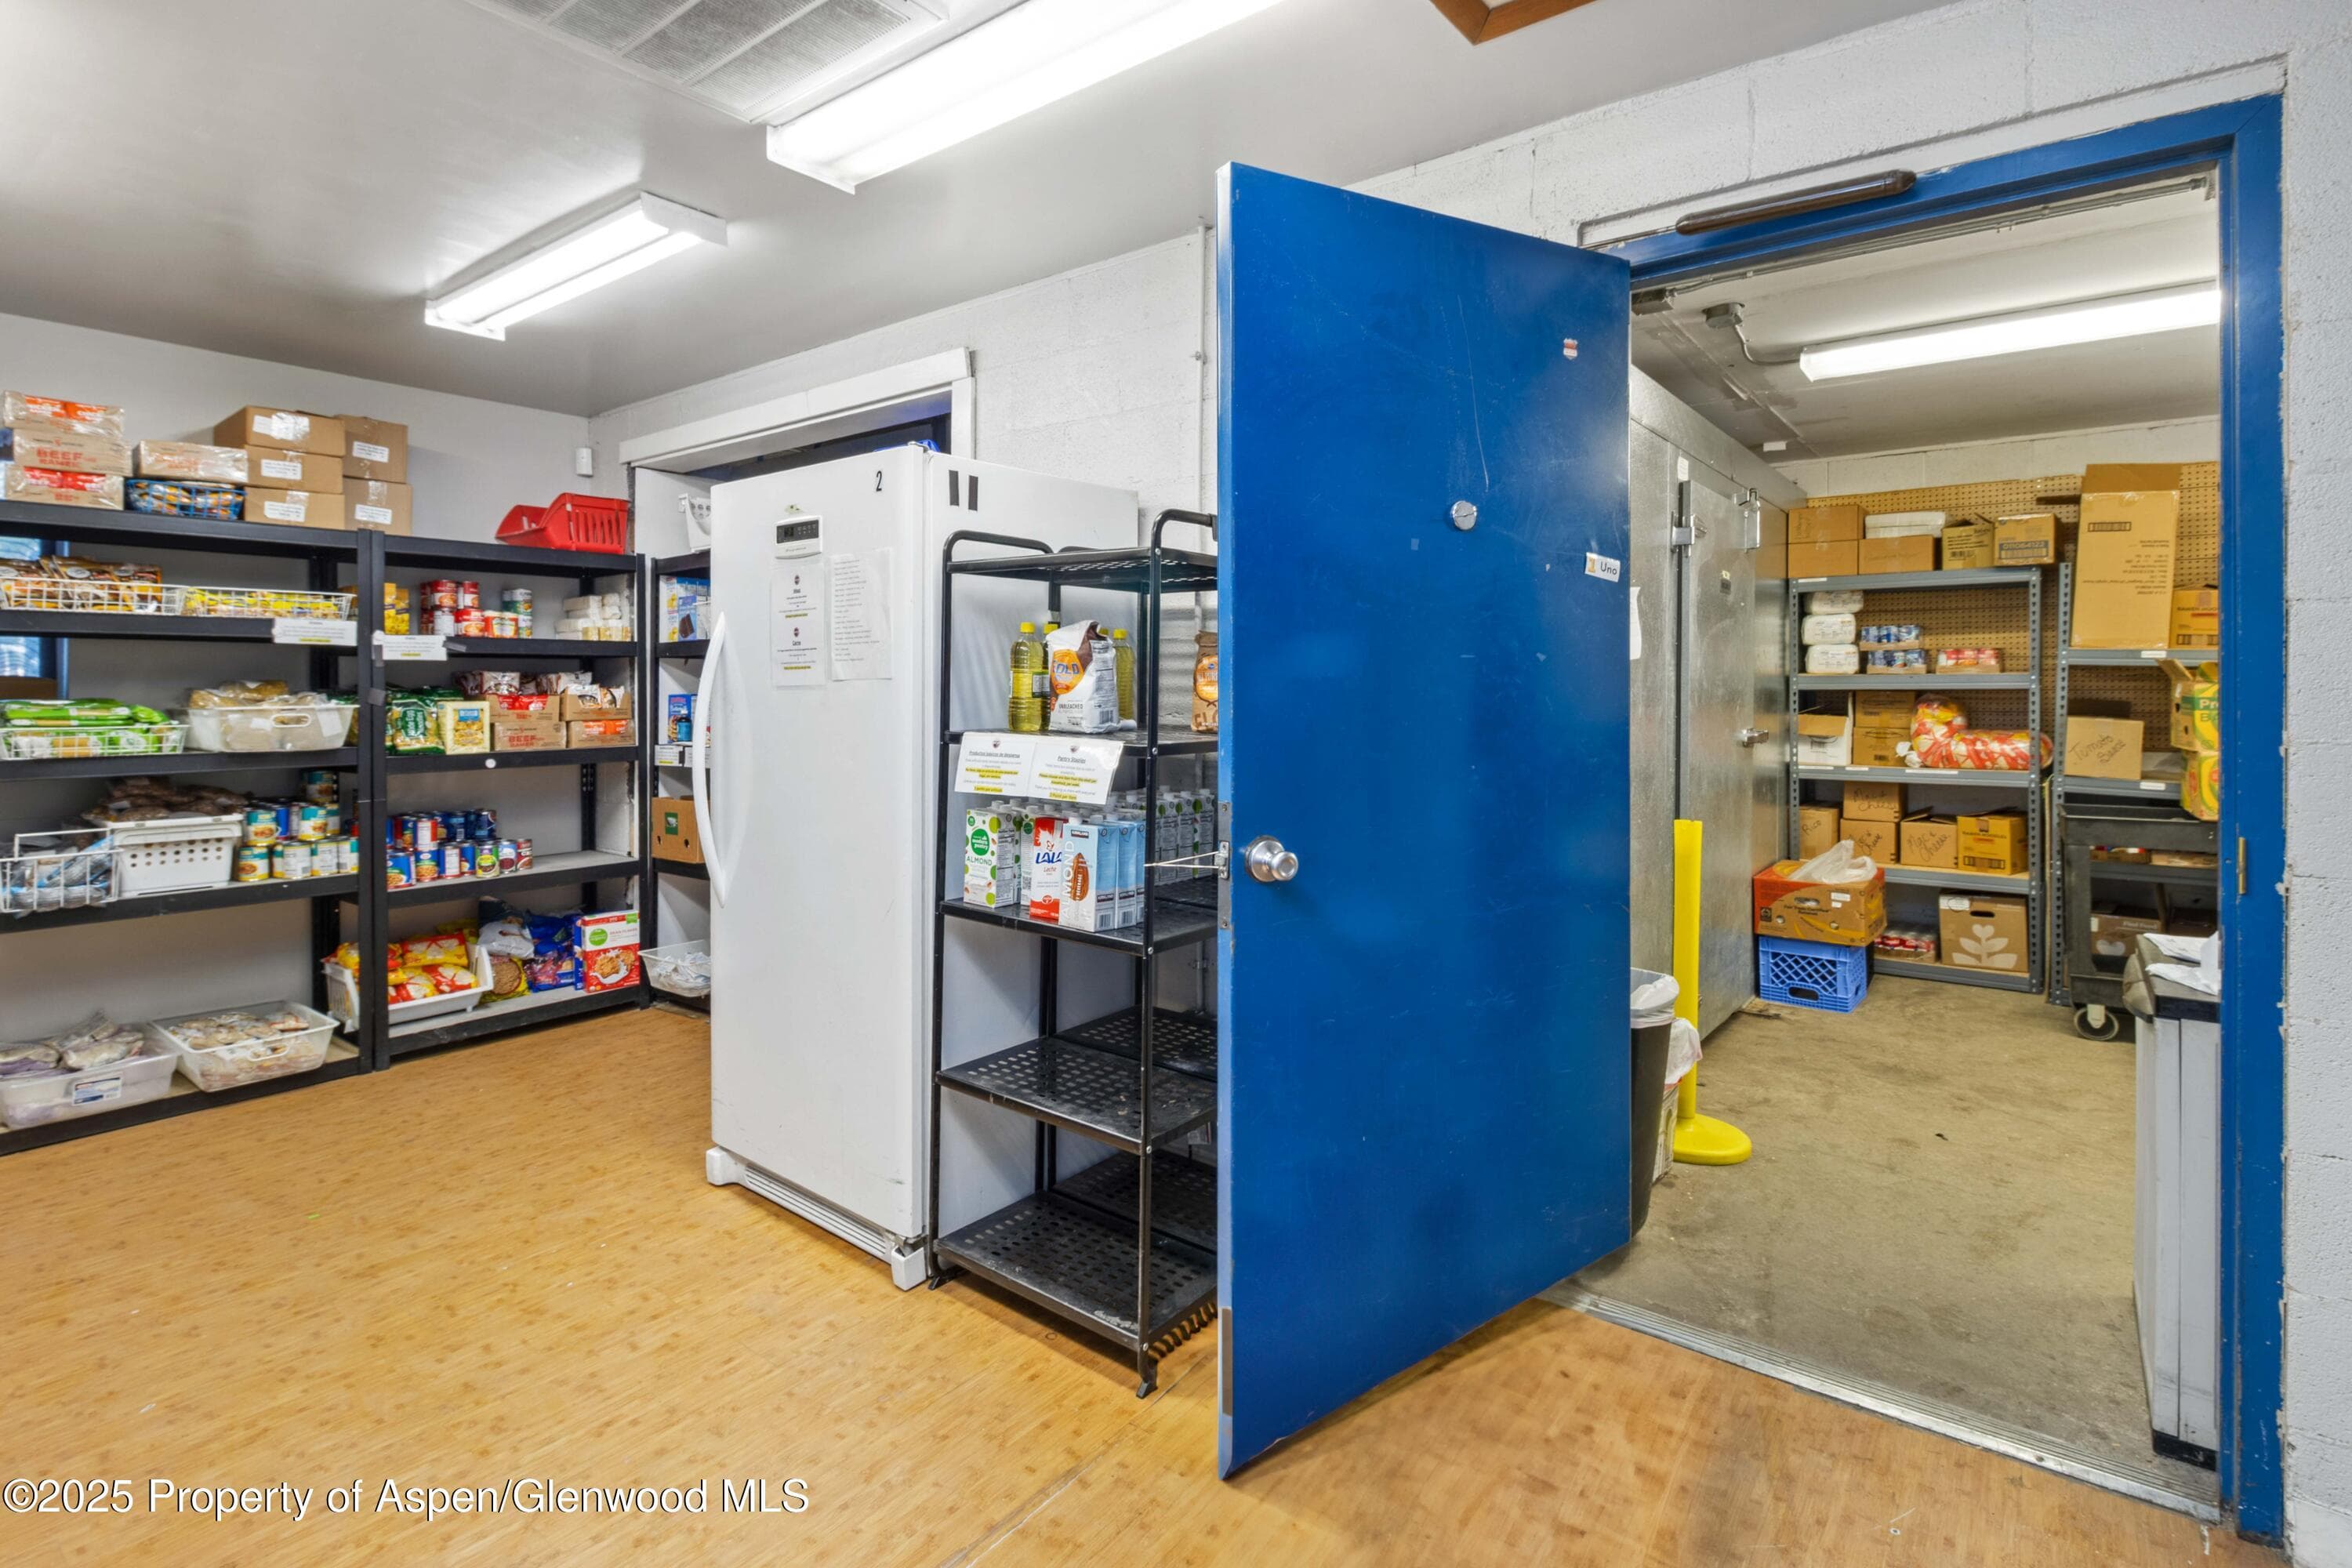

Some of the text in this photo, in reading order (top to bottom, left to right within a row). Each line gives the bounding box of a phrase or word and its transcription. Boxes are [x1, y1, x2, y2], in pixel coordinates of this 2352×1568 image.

[37, 448, 82, 461] BEEF
[875, 470, 883, 492] 2
[1600, 561, 1617, 575] Uno
[1802, 819, 1821, 836] Rice
[967, 856, 993, 866] ALMOND
[1062, 841, 1074, 916] ALMOND
